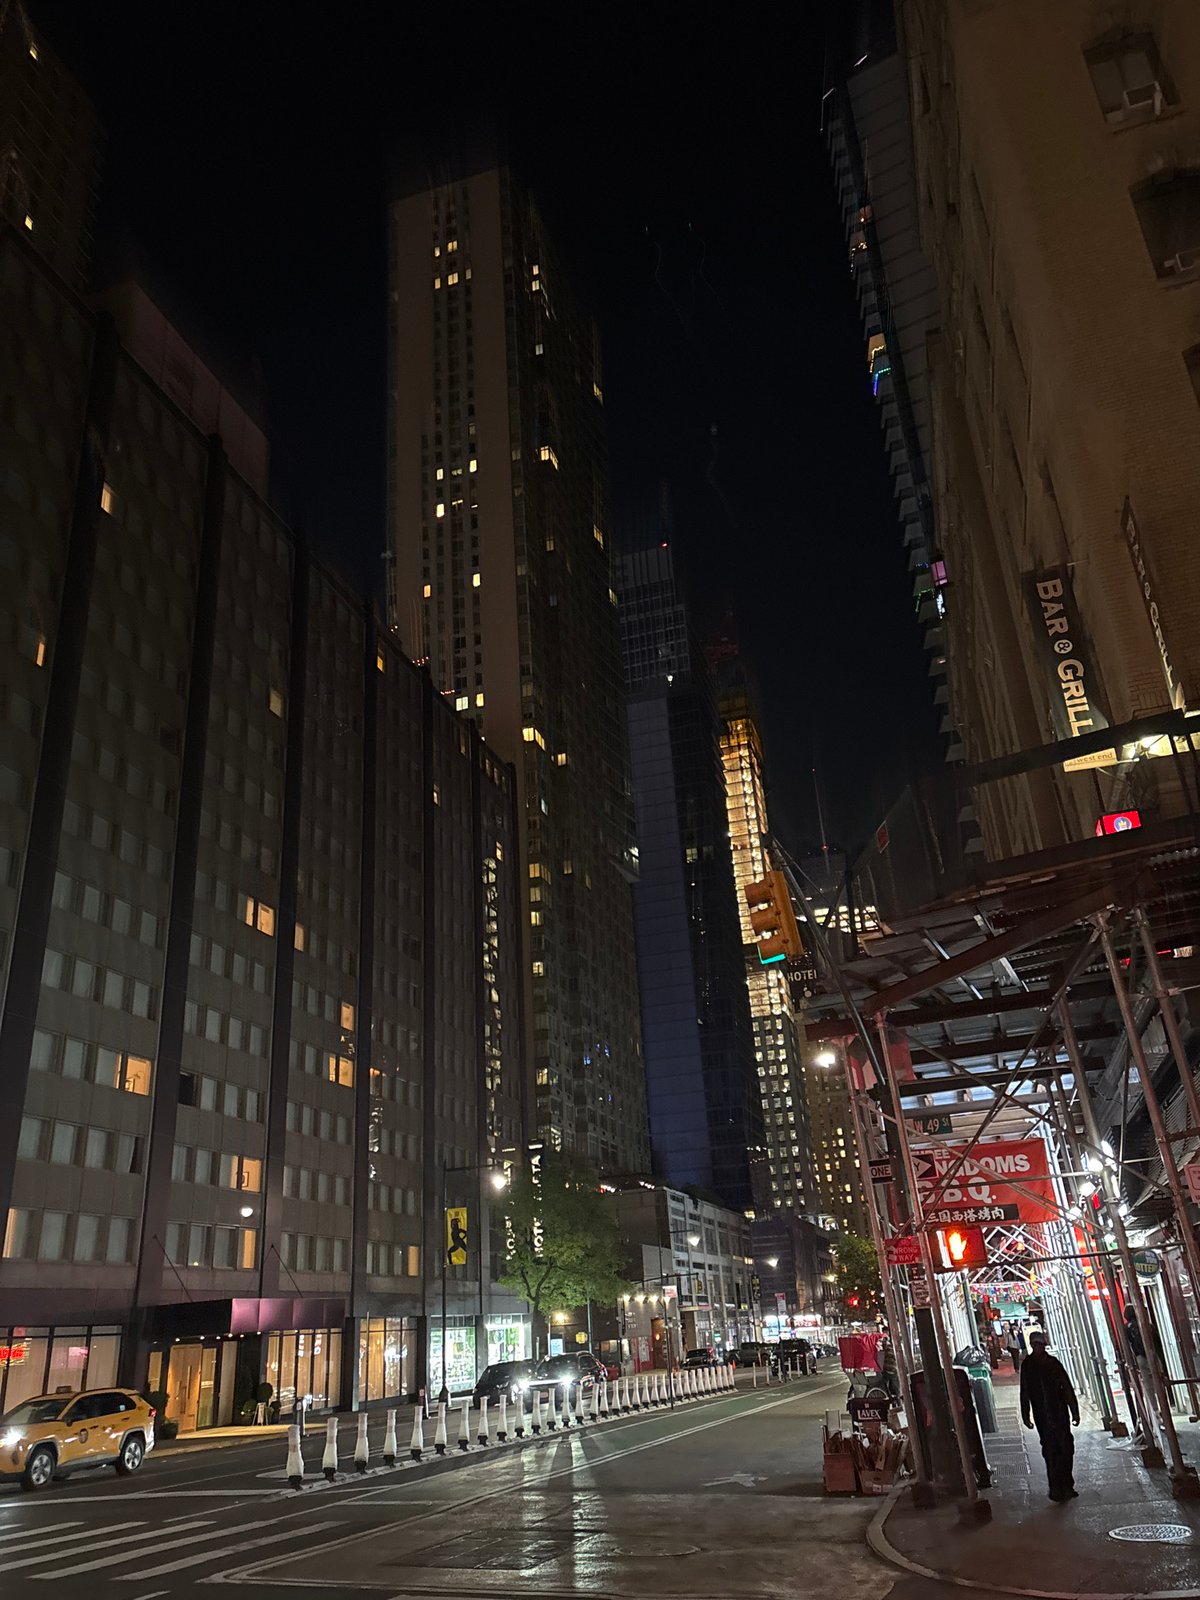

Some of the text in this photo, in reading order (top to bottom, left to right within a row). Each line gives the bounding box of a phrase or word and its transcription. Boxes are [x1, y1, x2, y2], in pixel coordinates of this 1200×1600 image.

[1036, 578, 1093, 737] BAR & GRILL
[1077, 751, 1113, 763] west end
[913, 1120, 923, 1134] W
[927, 1118, 940, 1133] 49
[870, 1165, 892, 1177] ONE
[898, 1254, 914, 1262] WAY
